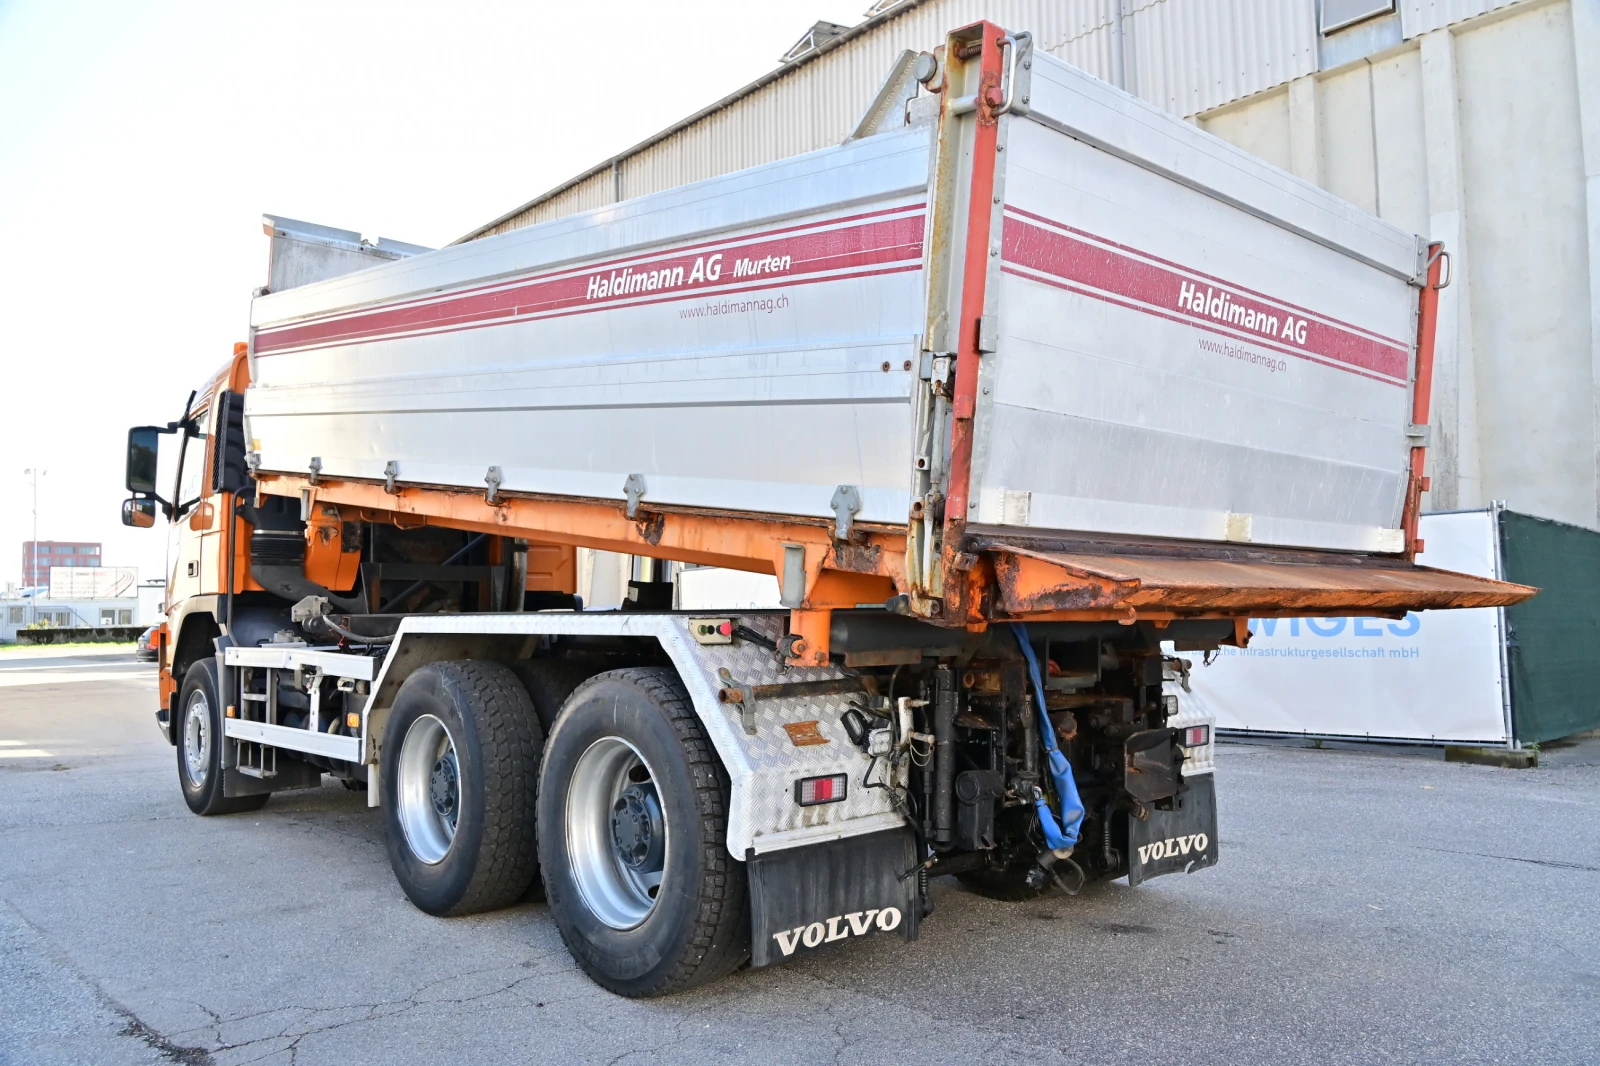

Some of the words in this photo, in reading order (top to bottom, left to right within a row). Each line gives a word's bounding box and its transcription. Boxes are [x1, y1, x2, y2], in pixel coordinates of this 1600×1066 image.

[586, 265, 684, 300] Haldimann
[688, 253, 723, 284] AG
[733, 255, 791, 278] Murten
[679, 293, 789, 319] www.haldimannag.ch
[1178, 280, 1278, 336] Haldimann
[1281, 316, 1308, 345] AG
[1198, 338, 1287, 372] www.haldimannag.ch
[1389, 646, 1420, 658] mbH
[1138, 833, 1208, 865] VOLVO
[772, 906, 902, 956] VOLVO
